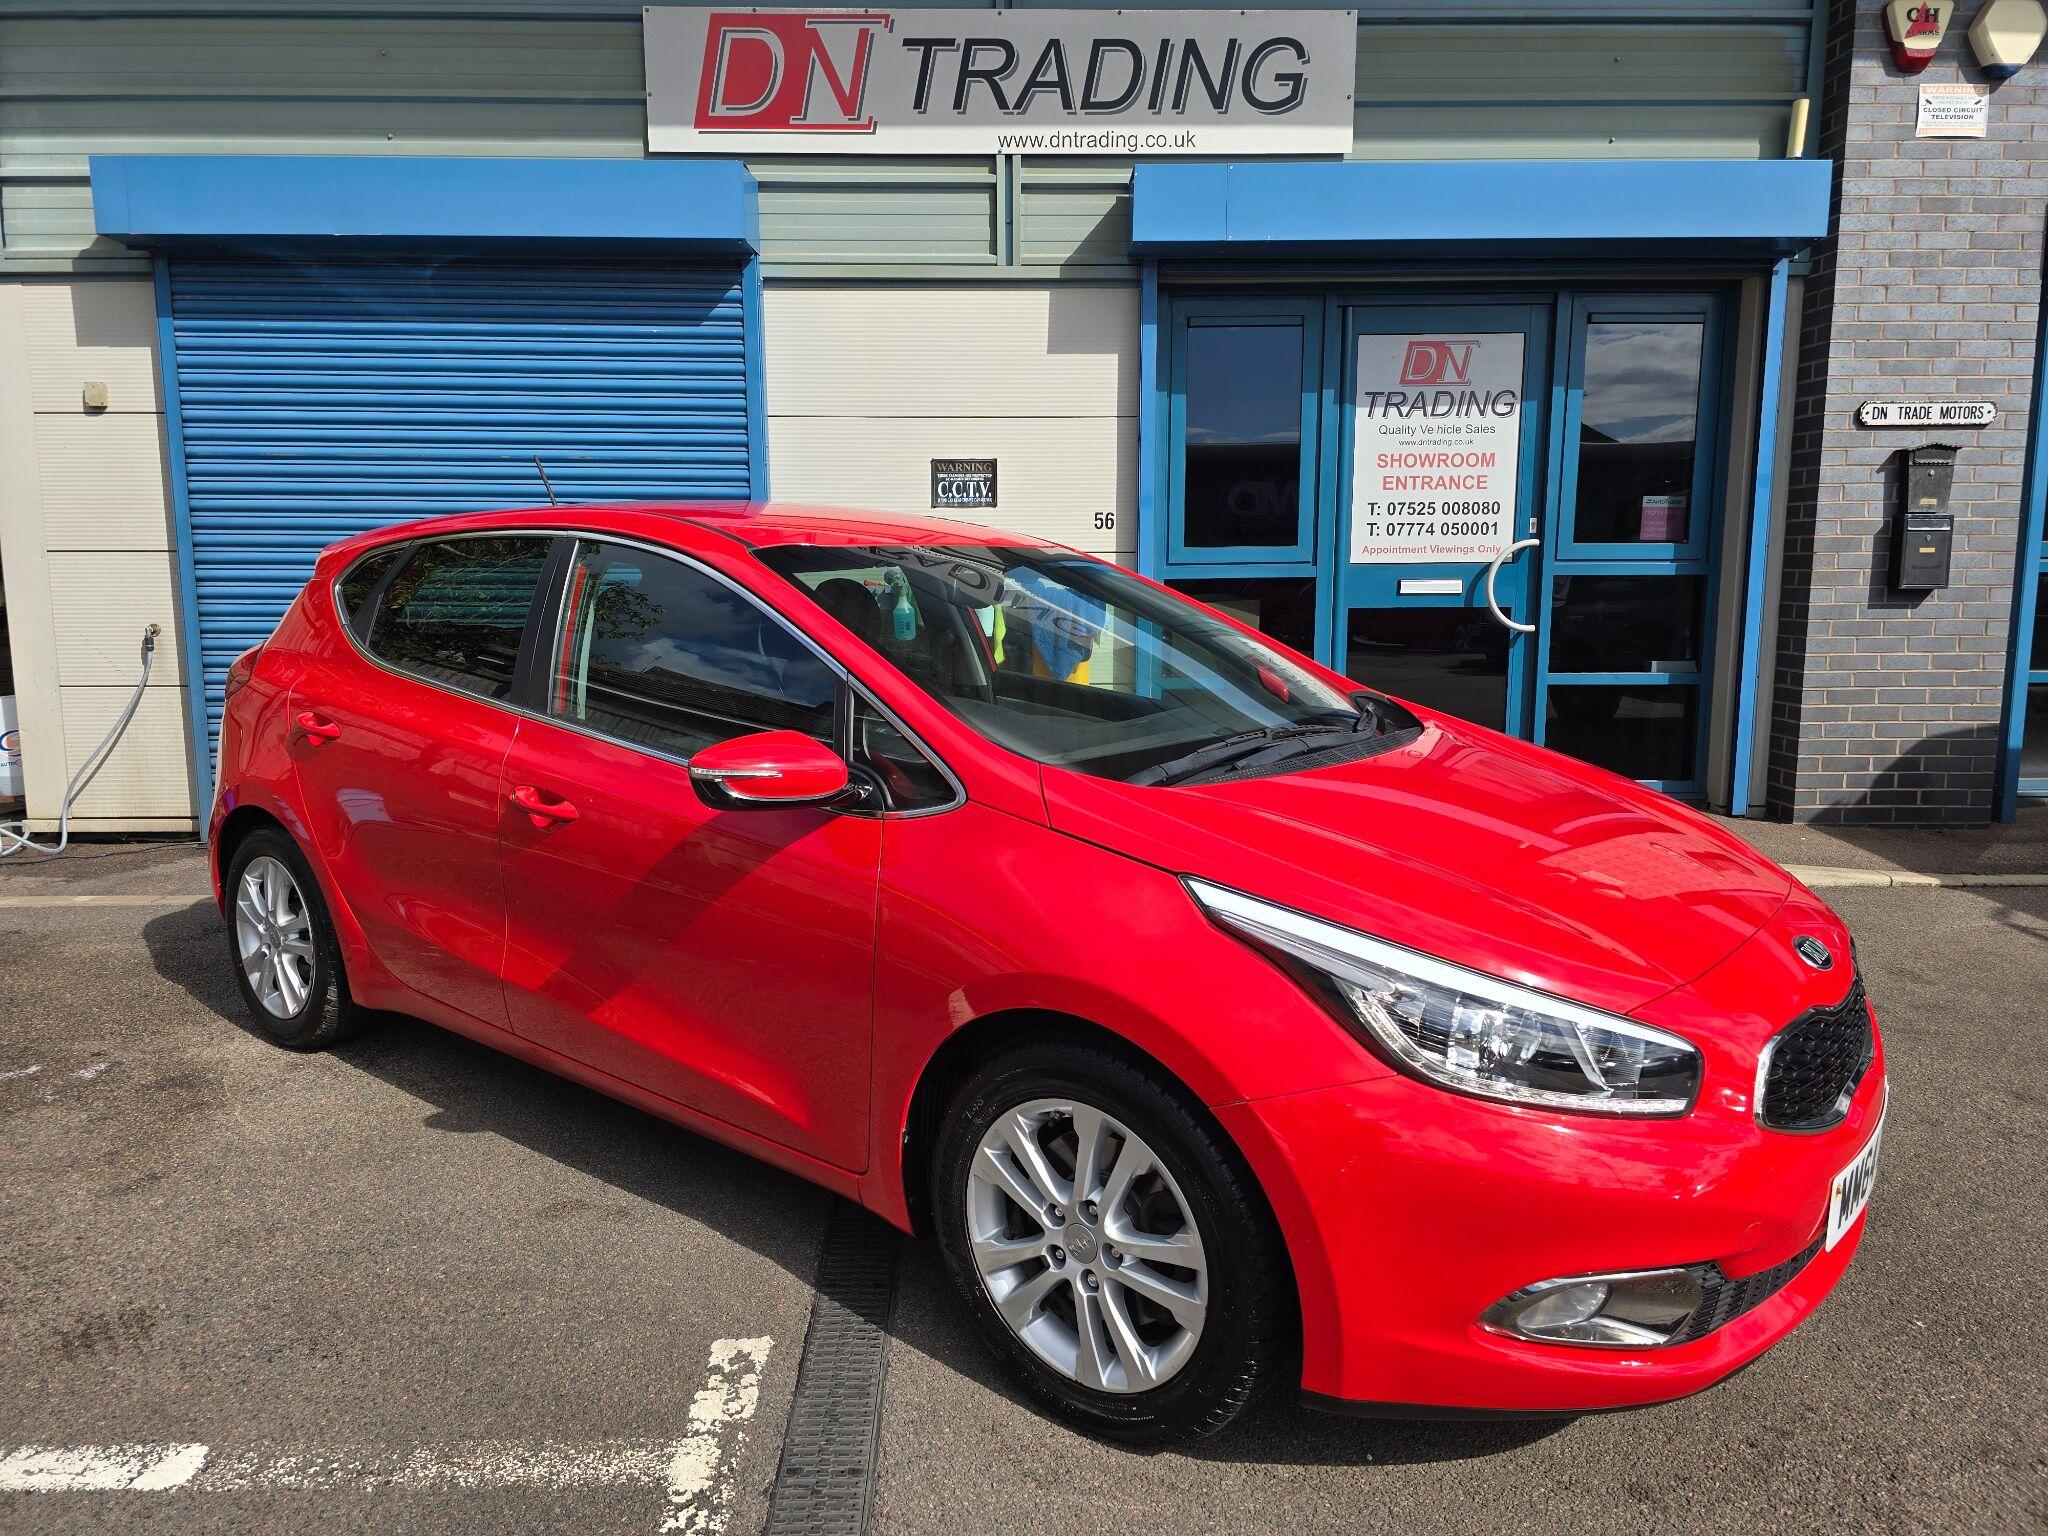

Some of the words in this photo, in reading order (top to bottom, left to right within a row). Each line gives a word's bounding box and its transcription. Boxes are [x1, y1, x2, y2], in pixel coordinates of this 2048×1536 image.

[700, 17, 893, 128] DN
[900, 36, 1311, 117] TRADING
[1926, 86, 1984, 95] WARNING
[997, 129, 1197, 153] www.dntrading.co.uk
[1400, 340, 1481, 387] DN
[1364, 389, 1518, 419] TRADING
[1872, 406, 1888, 420] DN
[1898, 405, 1933, 420] TRADE
[1939, 405, 1985, 420] MOTORS
[1378, 424, 1417, 437] Quality
[1420, 423, 1462, 435] Vehicle
[1465, 423, 1496, 434] Sales
[1398, 438, 1474, 447] www.dntrading.co.uk
[937, 462, 992, 472] WARNING
[1376, 452, 1496, 469] SHOWROOM
[937, 481, 992, 498] C.C.T.V.
[1382, 475, 1488, 491] ENTRANCE
[1367, 502, 1381, 516] T:
[1387, 502, 1436, 516] 07525
[1441, 501, 1501, 516] 008080
[1094, 512, 1115, 530] 56
[1366, 522, 1380, 536] T:
[1386, 522, 1436, 536] 07774
[1440, 521, 1498, 536] 050001
[1362, 545, 1426, 556] Appointment
[1430, 544, 1475, 555] Viewings
[1478, 544, 1501, 555] Only
